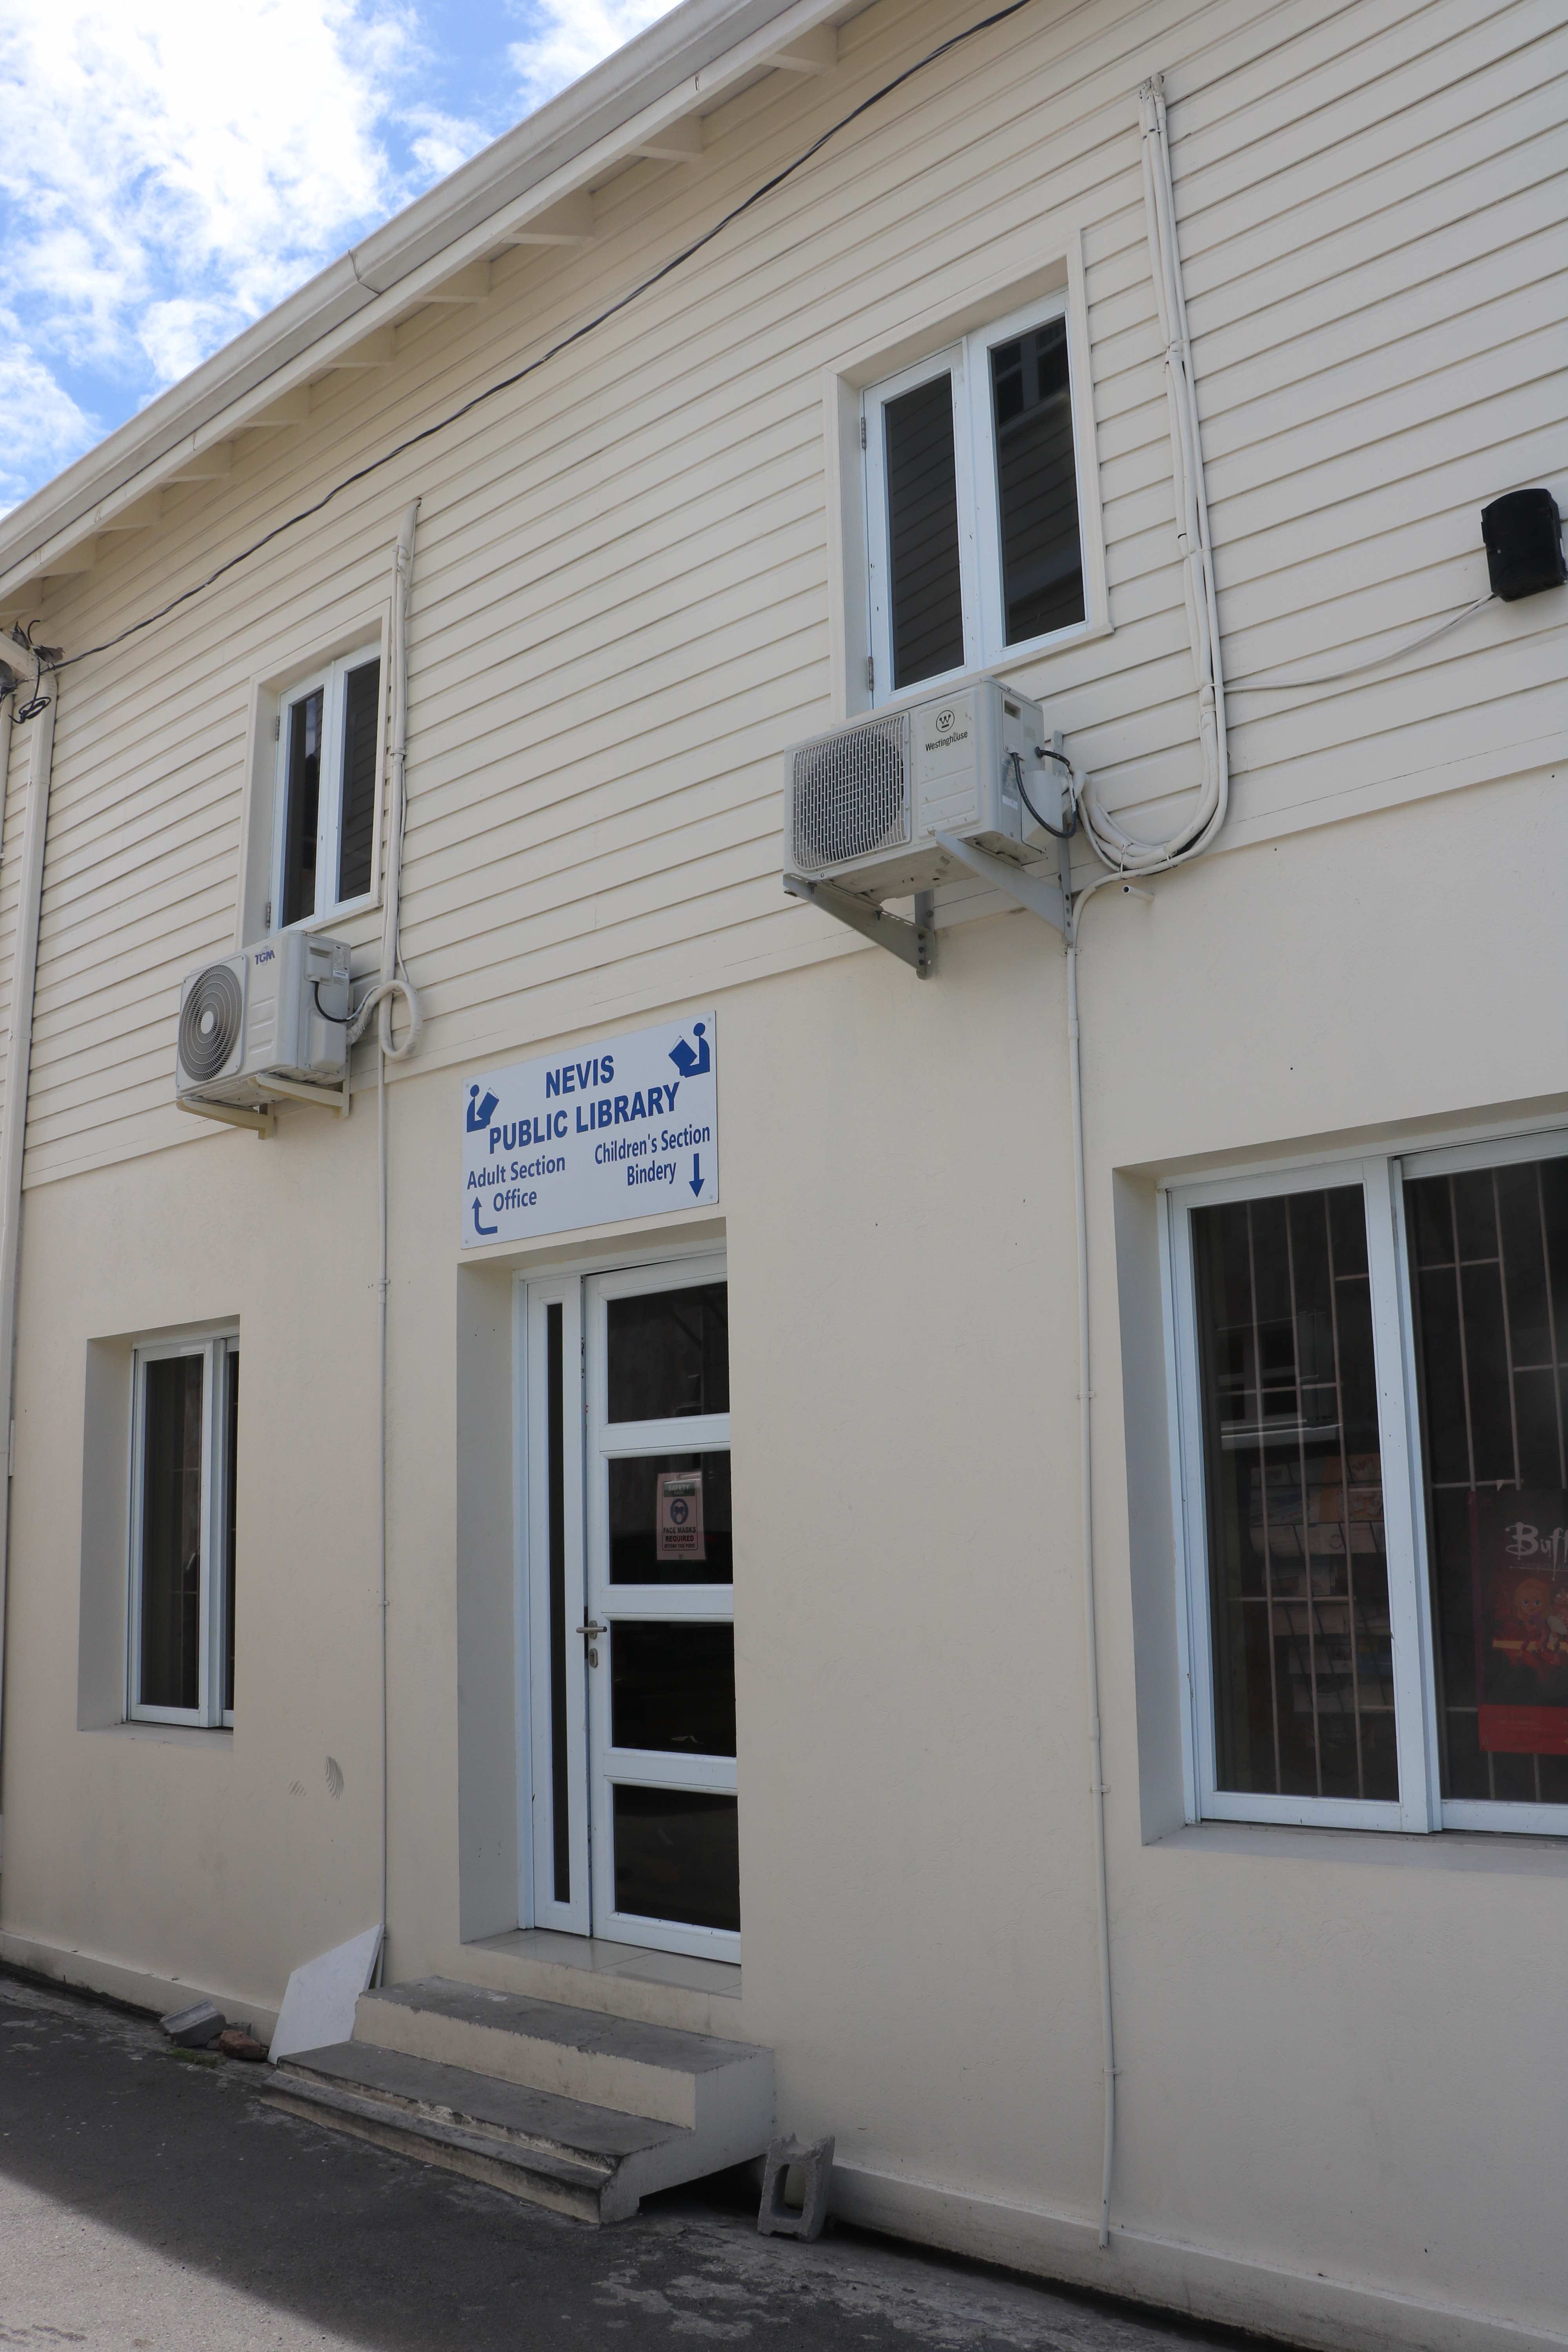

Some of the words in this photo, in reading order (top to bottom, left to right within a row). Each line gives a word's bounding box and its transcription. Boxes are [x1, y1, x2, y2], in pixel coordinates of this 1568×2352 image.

[925, 731, 968, 752] Westinghouse
[255, 949, 276, 965] TGM
[546, 1055, 614, 1098] NEVIS
[490, 1110, 568, 1154] PUBLIC
[576, 1082, 680, 1133] LIBRARY
[594, 1134, 657, 1165] Children's
[661, 1123, 710, 1151] Section
[467, 1165, 506, 1190] Adult
[510, 1155, 565, 1181] Section
[627, 1159, 677, 1186] Bindery
[493, 1188, 537, 1212] Office
